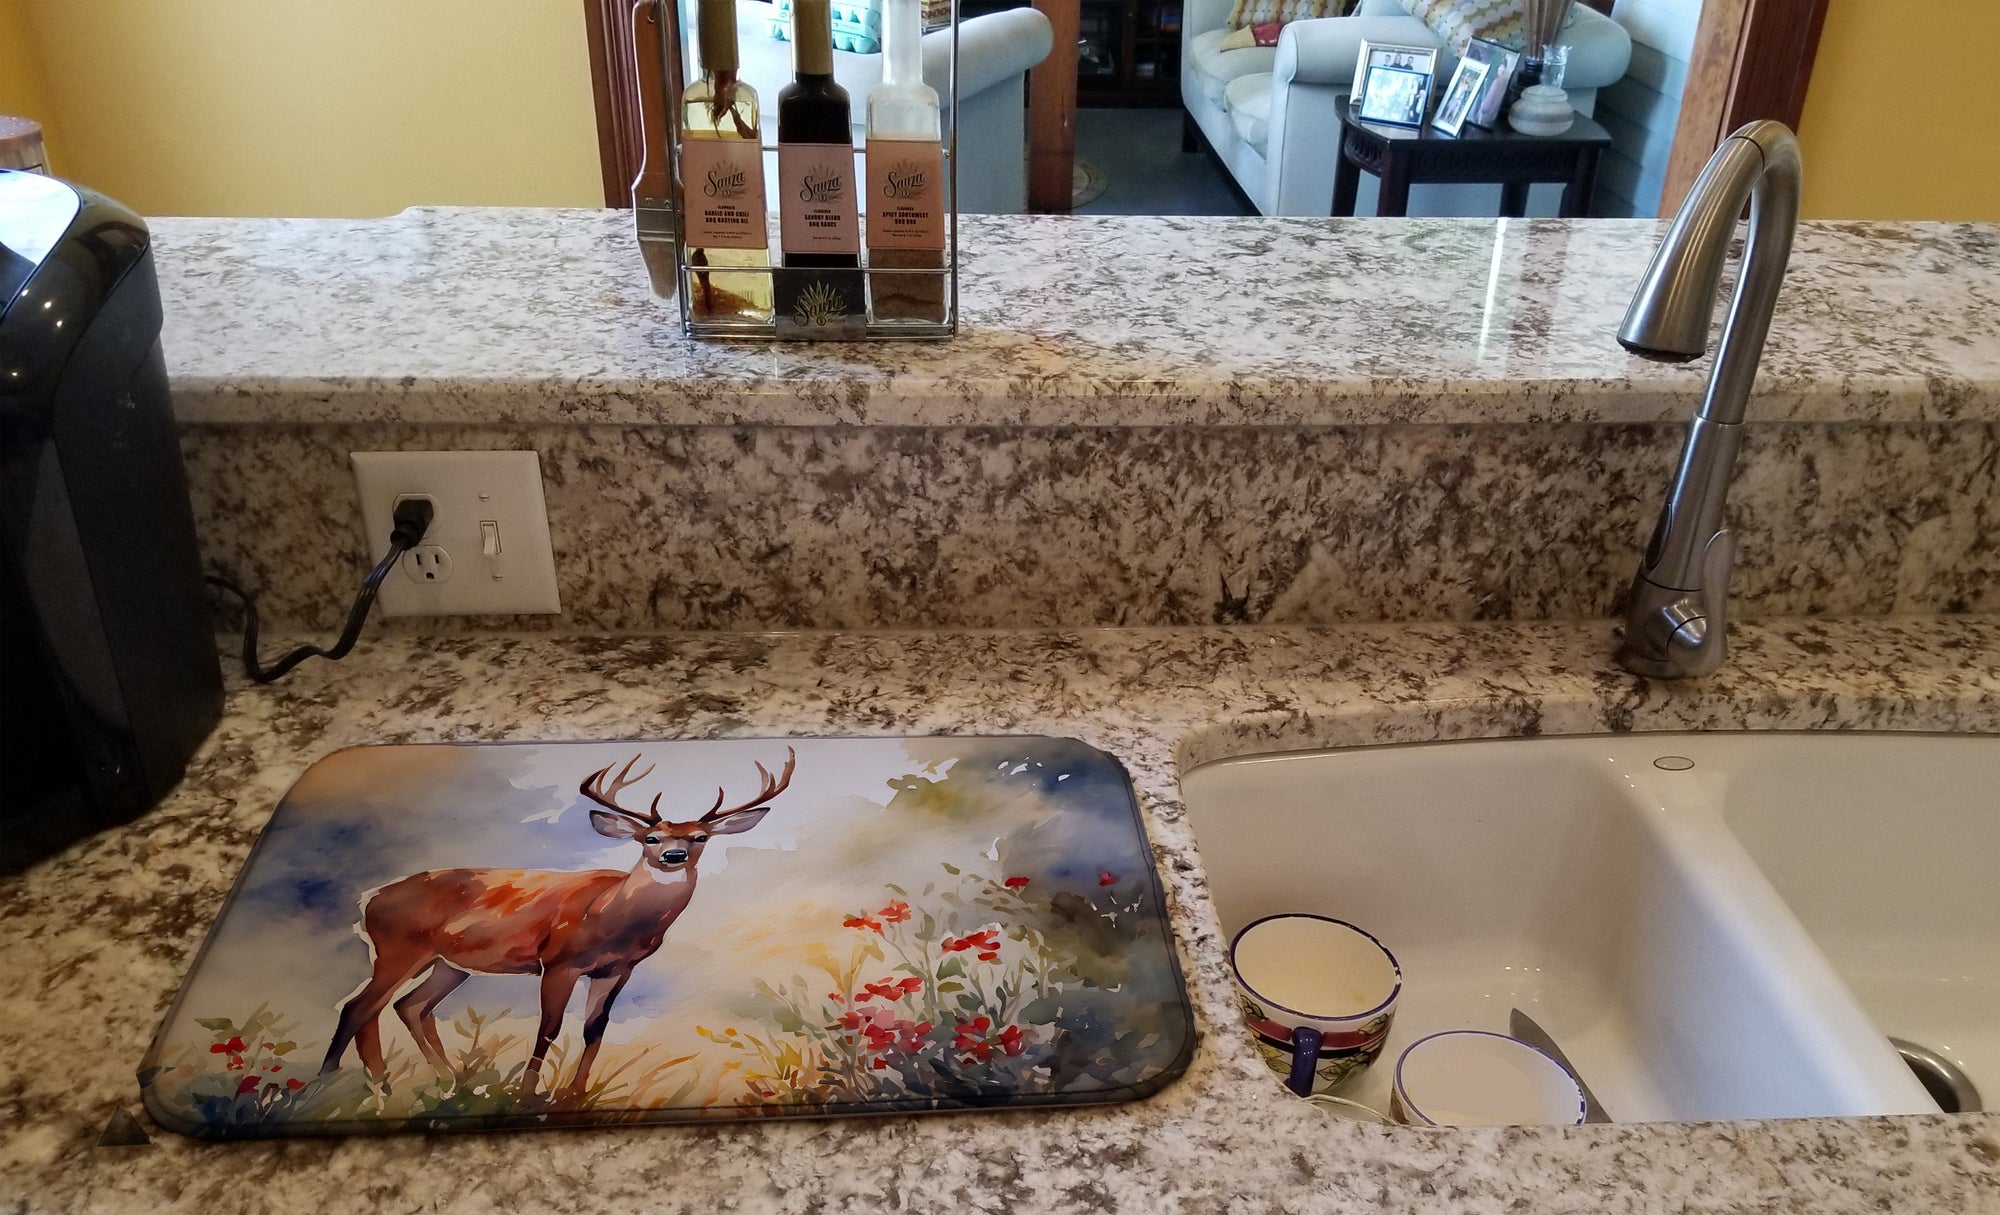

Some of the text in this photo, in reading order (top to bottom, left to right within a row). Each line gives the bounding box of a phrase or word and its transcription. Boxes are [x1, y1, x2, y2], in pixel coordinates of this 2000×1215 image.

[704, 170, 746, 197] Sauza
[800, 175, 842, 202] Sauza
[884, 171, 926, 198] Sauza
